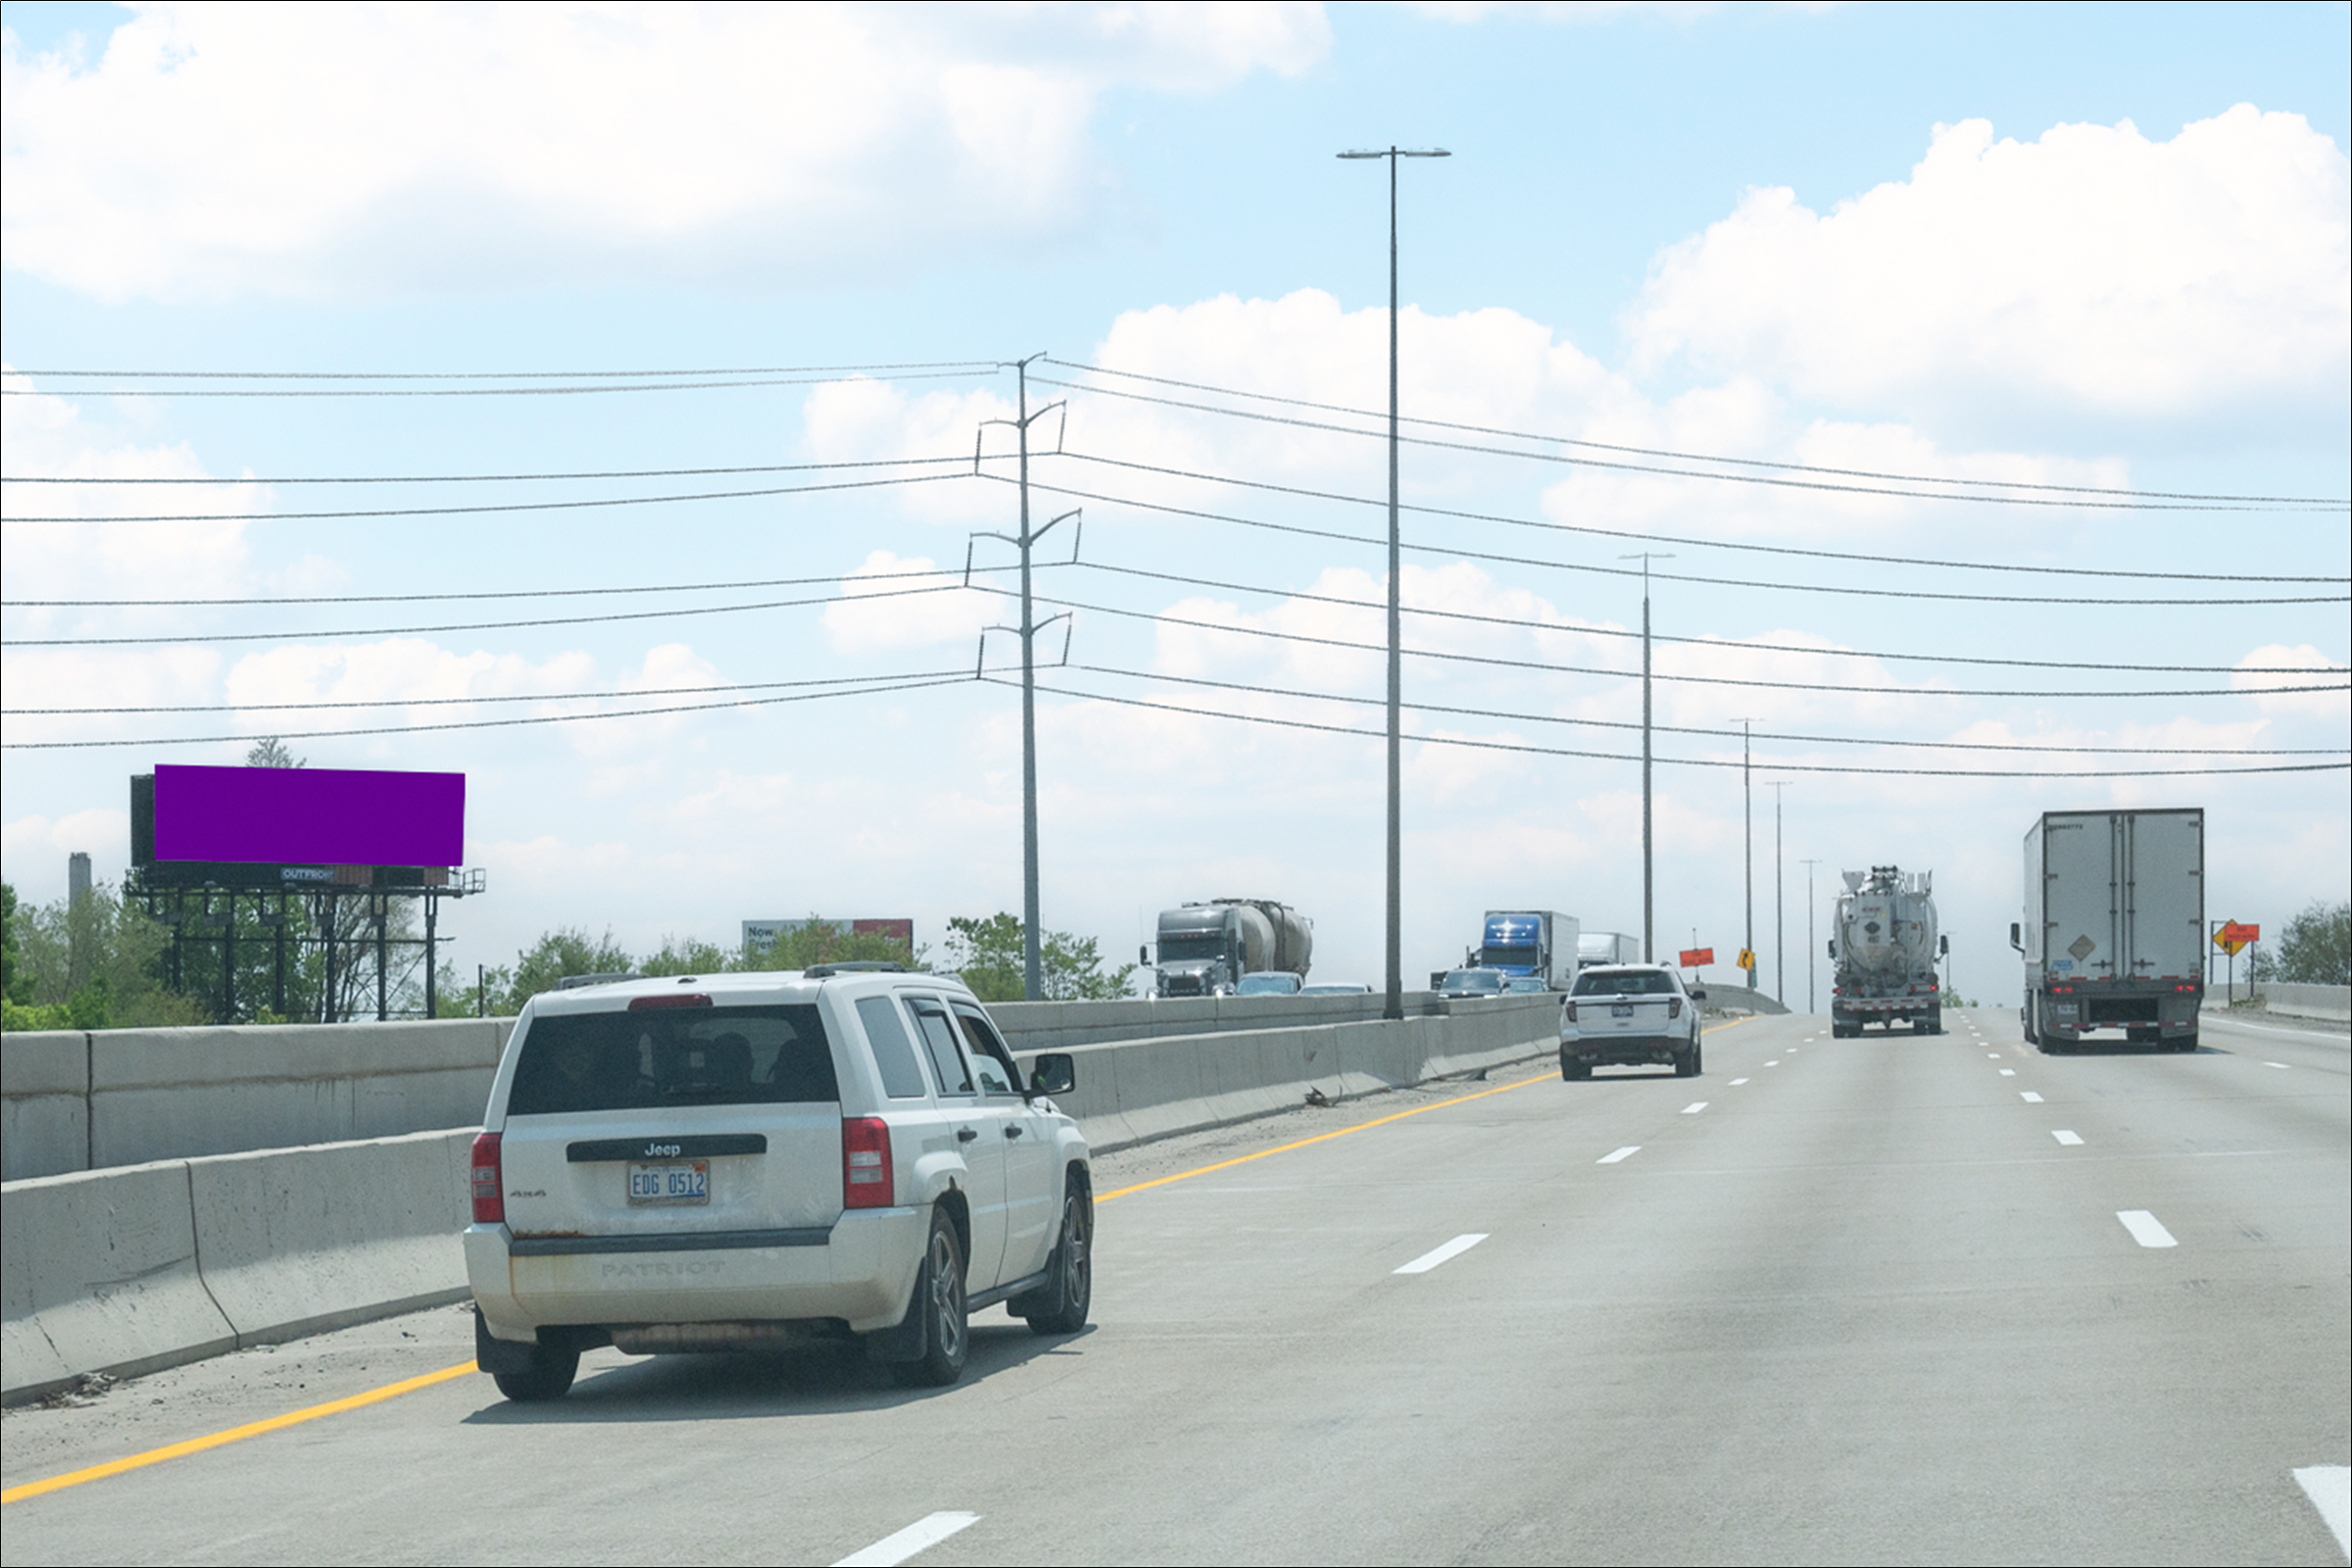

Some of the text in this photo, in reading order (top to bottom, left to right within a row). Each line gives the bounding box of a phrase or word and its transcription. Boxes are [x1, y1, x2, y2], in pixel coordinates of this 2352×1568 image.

[748, 926, 773, 937] Now
[645, 1143, 680, 1157] Jeep
[632, 1173, 705, 1195] EDG 0512
[602, 1261, 725, 1277] PATRIOT
